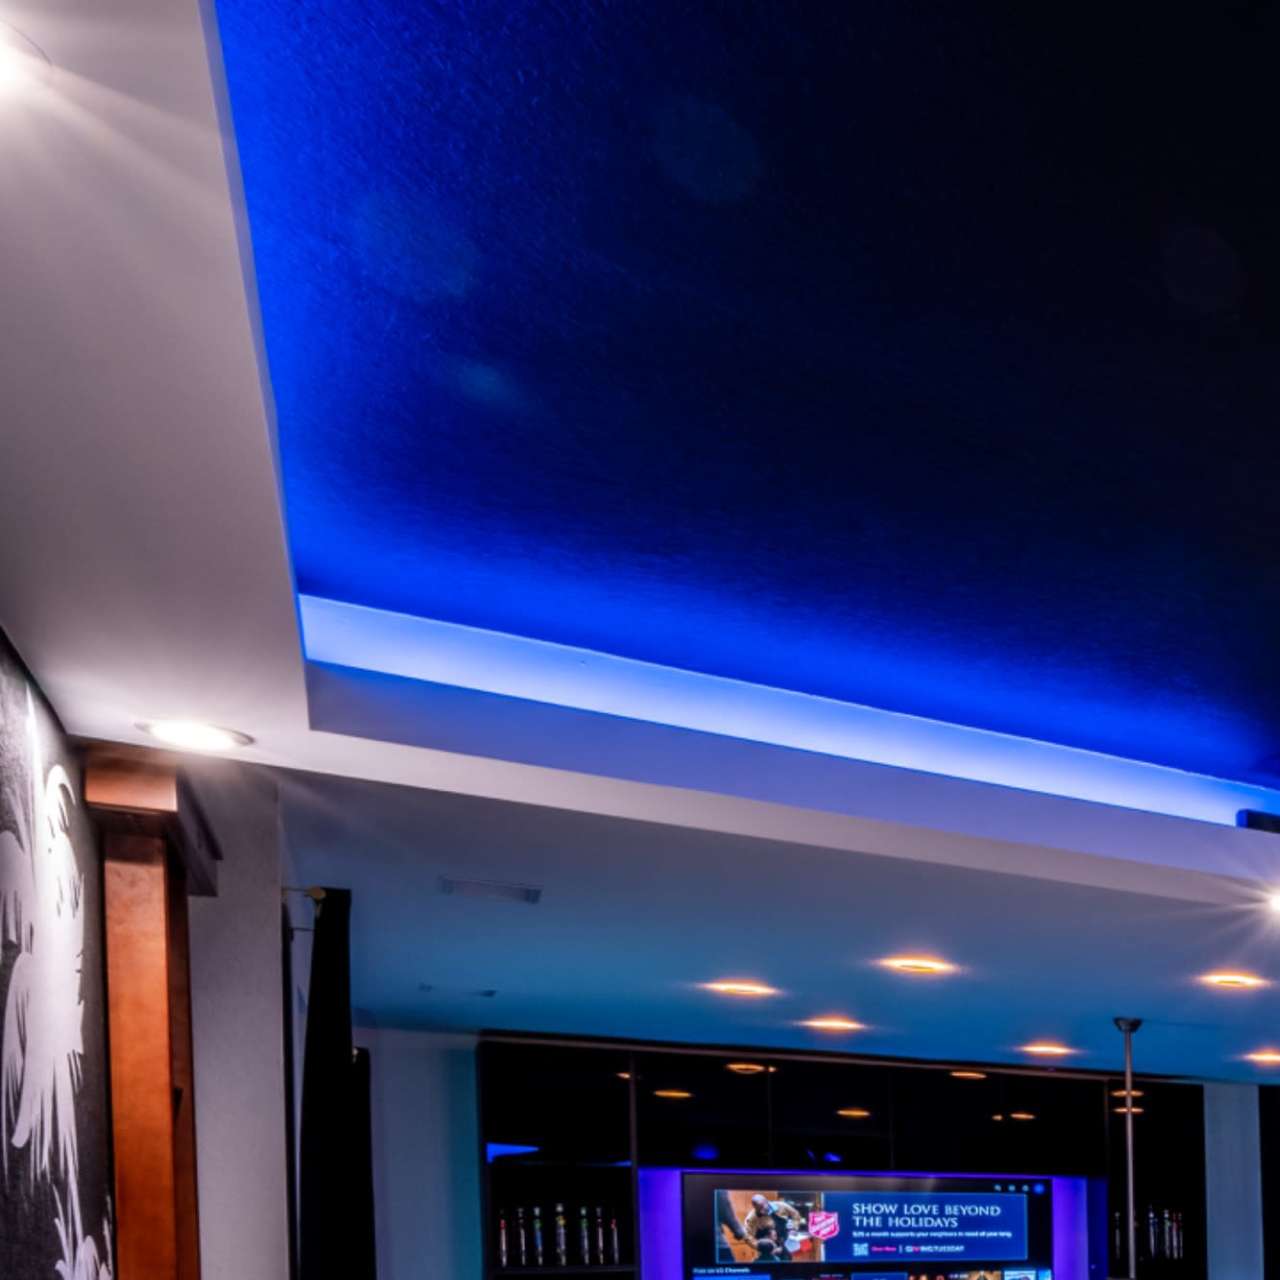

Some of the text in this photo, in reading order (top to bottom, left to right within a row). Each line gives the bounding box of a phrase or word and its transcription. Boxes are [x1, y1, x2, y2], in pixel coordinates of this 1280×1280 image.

[852, 1203, 1001, 1217] SHOW LOVE BEYOND
[852, 1216, 882, 1227] THE
[888, 1216, 959, 1228] HOLIDAYS
